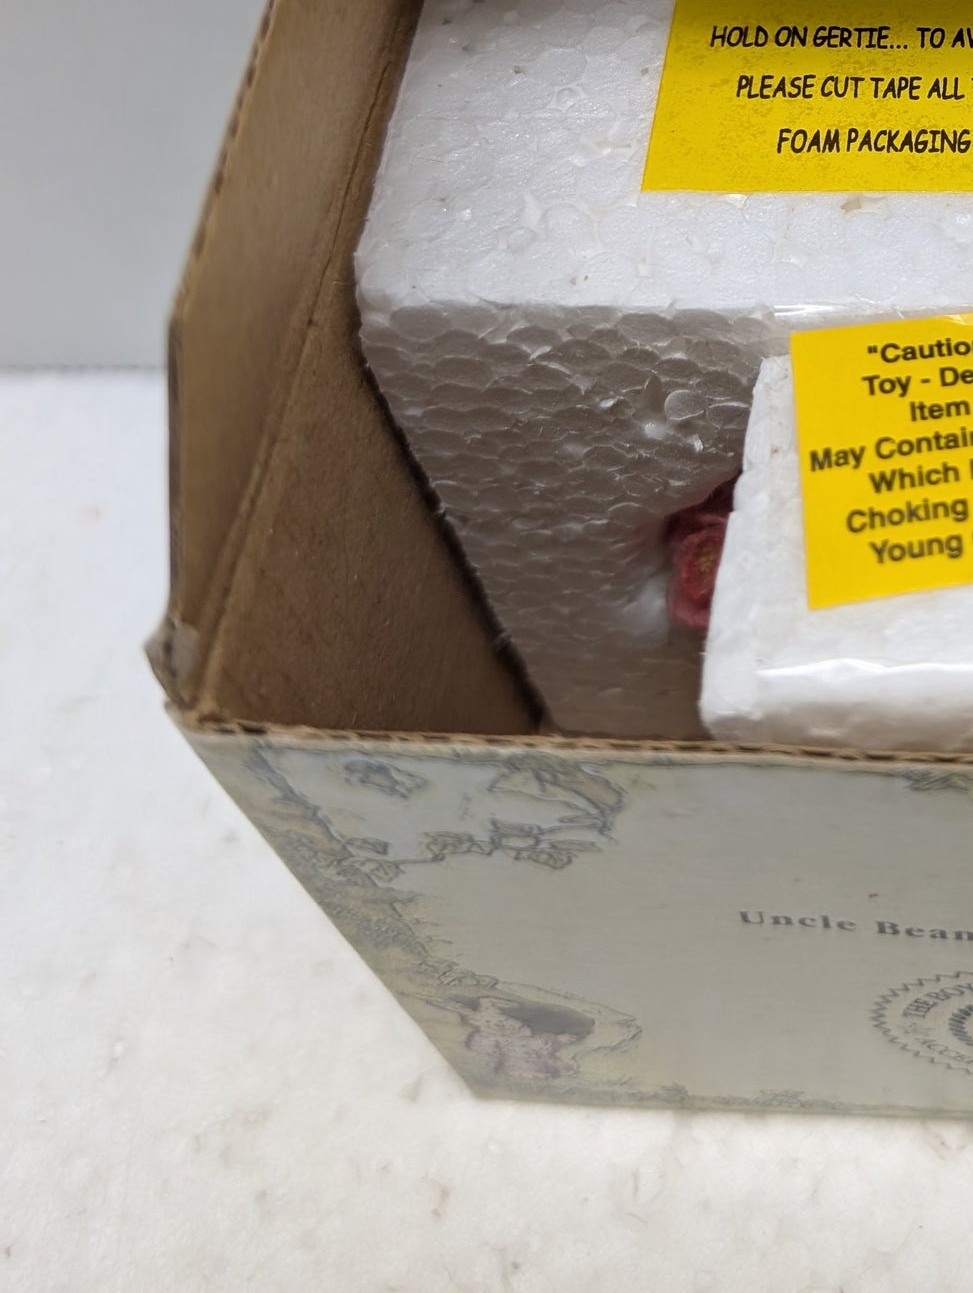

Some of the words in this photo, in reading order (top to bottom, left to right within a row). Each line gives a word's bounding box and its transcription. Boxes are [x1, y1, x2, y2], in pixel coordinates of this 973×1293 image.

[710, 25, 768, 48] HOLD
[774, 26, 809, 48] ON
[812, 26, 909, 50] GERTIE...
[916, 27, 946, 49] TO
[736, 74, 816, 100] PLEASE
[820, 76, 865, 99] CUT
[870, 77, 922, 100] TAPE
[927, 77, 966, 100] ALL
[777, 128, 841, 154] FOAM
[846, 128, 971, 154] PACKAGING
[862, 373, 911, 397] Toy
[909, 398, 971, 423] Item
[809, 444, 866, 473] May
[869, 460, 960, 494] Which
[846, 496, 969, 535] Choking
[869, 530, 965, 565] Young
[739, 911, 857, 932] Uncle
[902, 997, 939, 1019] THE
